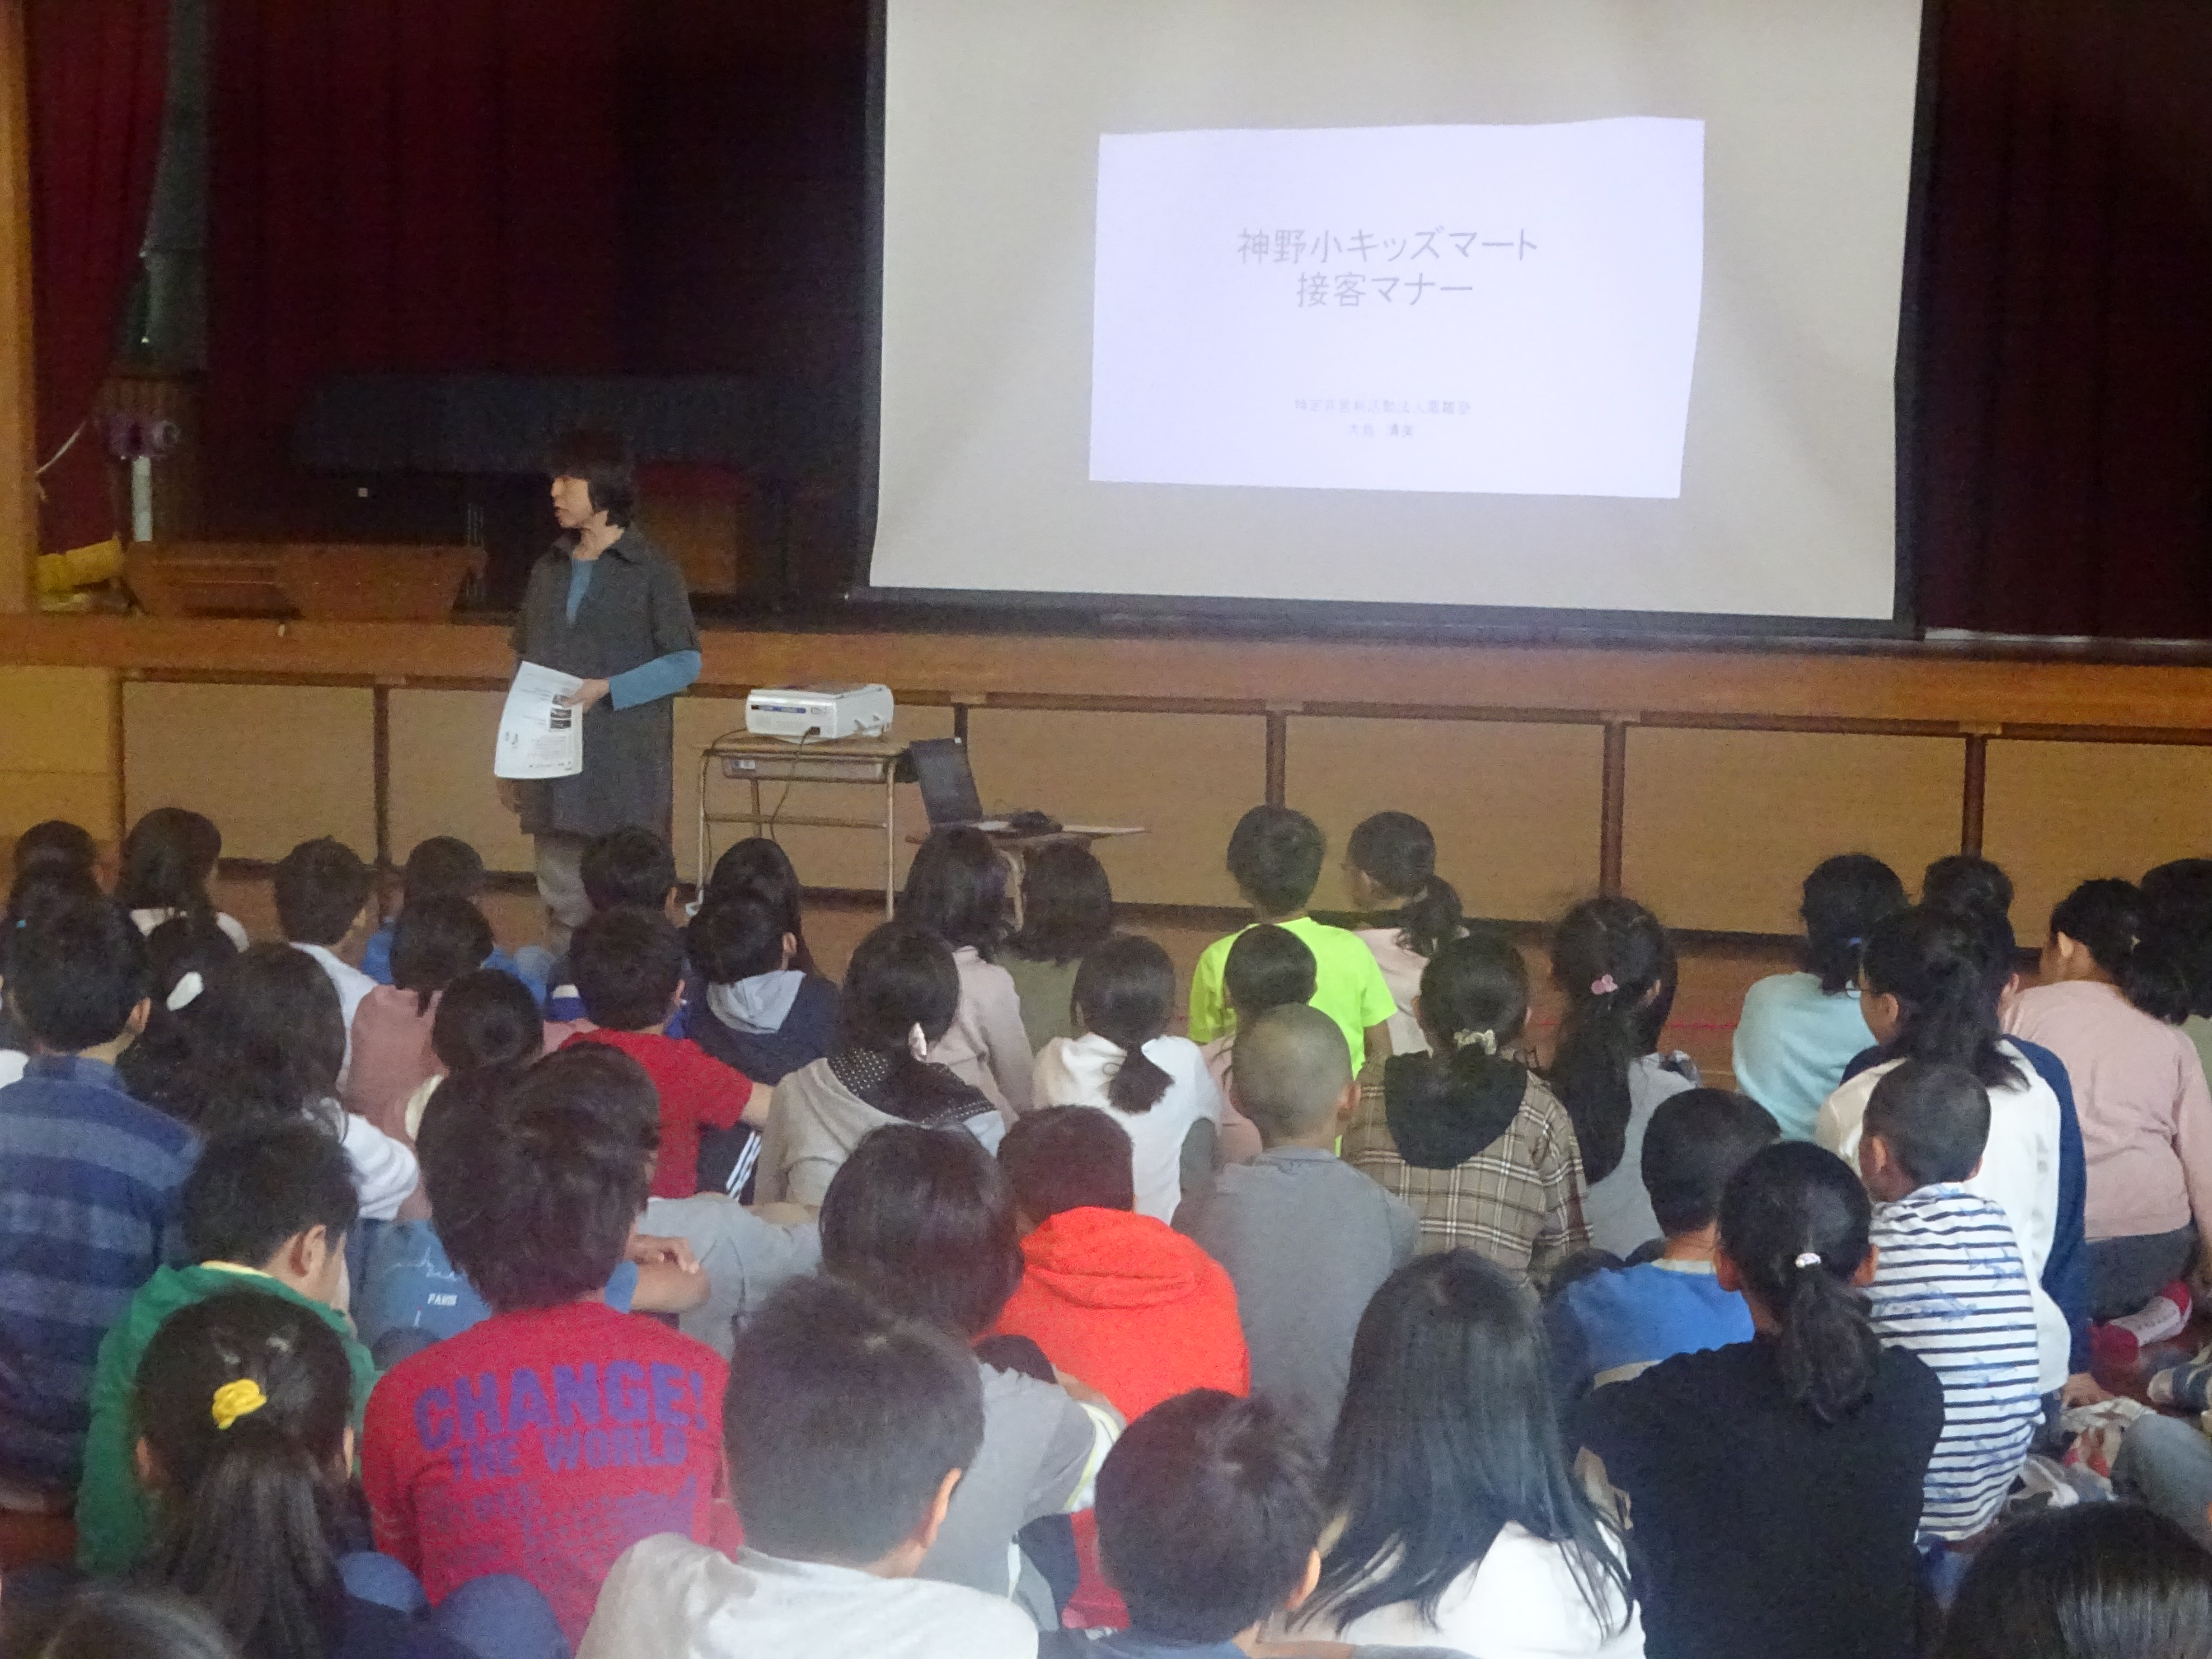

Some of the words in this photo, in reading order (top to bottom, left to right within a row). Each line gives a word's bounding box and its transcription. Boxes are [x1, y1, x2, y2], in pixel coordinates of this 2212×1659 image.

[1237, 225, 1537, 264] 神野小キッズマート
[1297, 271, 1473, 308] 接客マナー
[414, 1360, 707, 1451] CHANGE!
[448, 1435, 522, 1482] THE
[543, 1425, 688, 1473] WORLD
